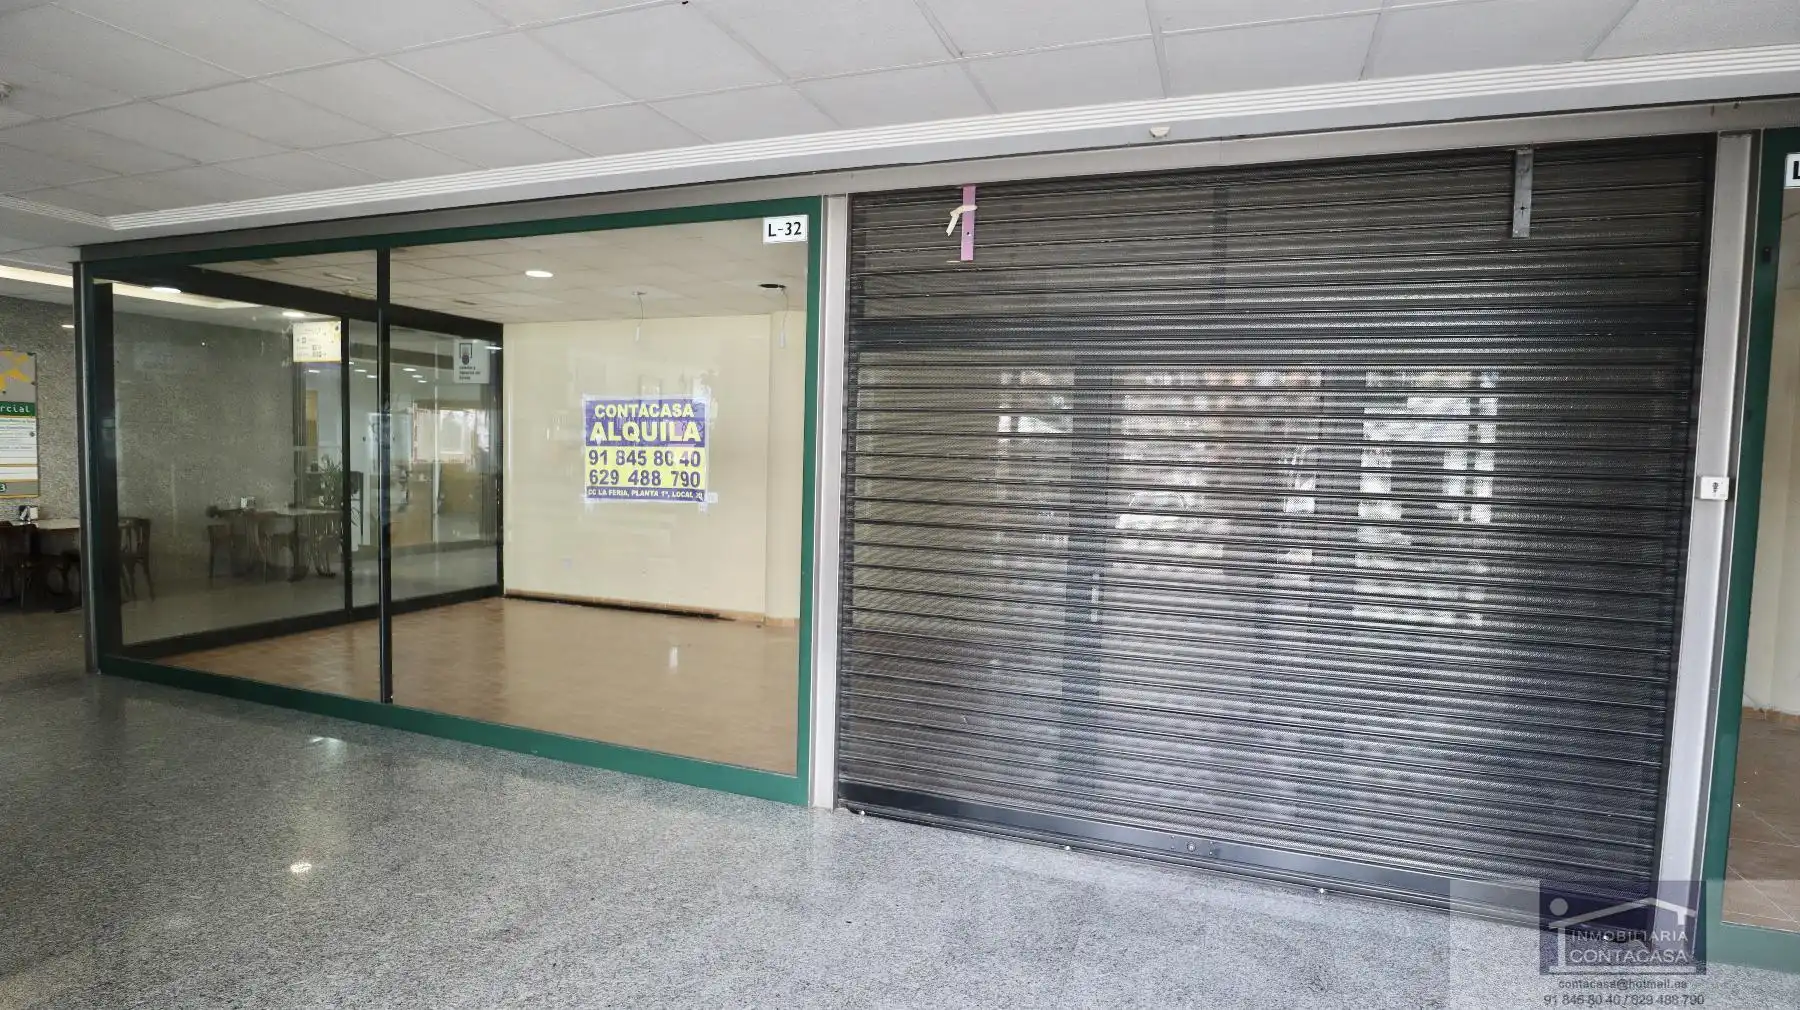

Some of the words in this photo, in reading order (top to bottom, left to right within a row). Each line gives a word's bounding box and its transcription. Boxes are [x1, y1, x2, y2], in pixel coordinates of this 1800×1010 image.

[768, 221, 802, 237] L-32
[594, 403, 695, 418] CONTACASA
[589, 420, 702, 442] ALQUILA
[588, 449, 608, 465] 91
[615, 449, 647, 466] 845
[653, 450, 674, 467] 80
[679, 451, 701, 467] 40
[588, 469, 620, 485] 629
[627, 469, 661, 486] 488
[671, 470, 701, 488] 790
[608, 489, 630, 498] FERIA,
[631, 489, 659, 498] PLANTA
[671, 491, 694, 499] LOCAL
